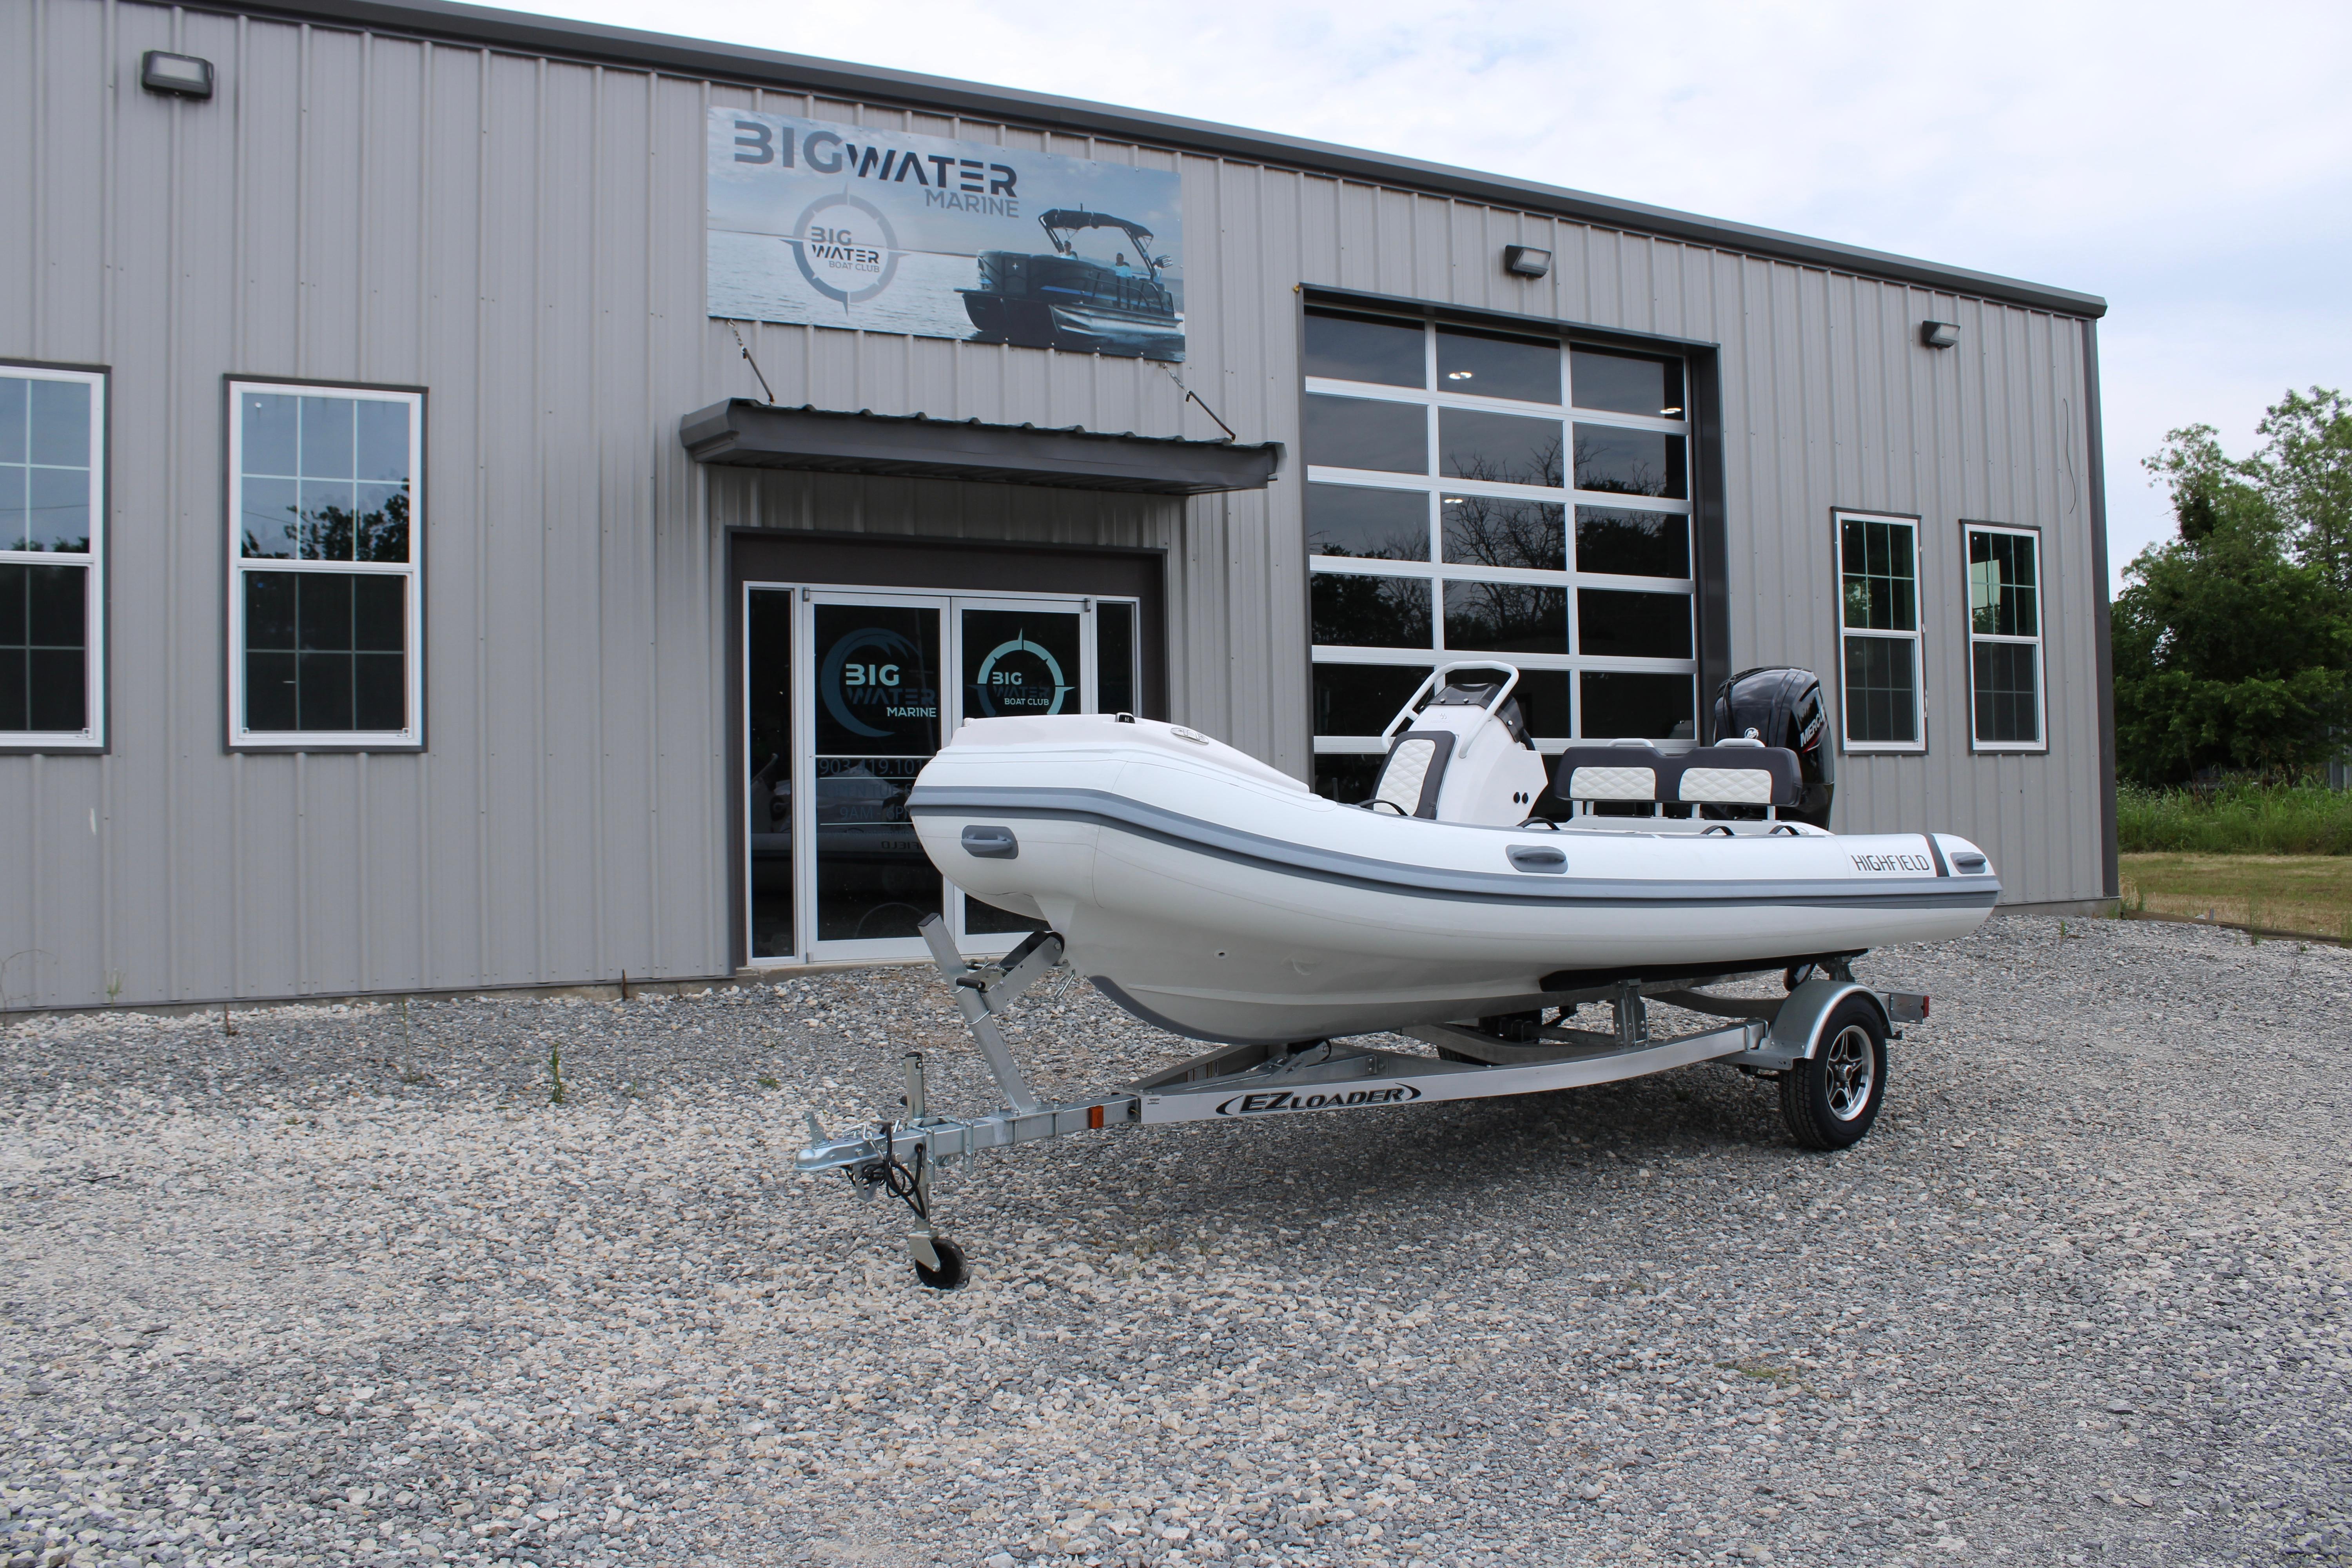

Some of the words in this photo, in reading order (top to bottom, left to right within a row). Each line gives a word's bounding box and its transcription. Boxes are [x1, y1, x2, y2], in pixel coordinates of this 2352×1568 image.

[926, 189, 1019, 218] MARINE
[811, 226, 852, 246] BIG
[811, 244, 880, 264] WATER
[829, 260, 853, 271] BOAT
[855, 261, 880, 273] CLUB
[846, 664, 899, 685] BIG
[992, 672, 1022, 685] BIG
[847, 688, 936, 705] WATER
[993, 686, 1050, 698] WATER
[887, 706, 936, 717] MARINE
[824, 784, 866, 797] OPEN
[840, 806, 873, 820] 9AM
[1850, 855, 1930, 871] HIGHFIELD
[1239, 1087, 1405, 1113] EZLOADER
